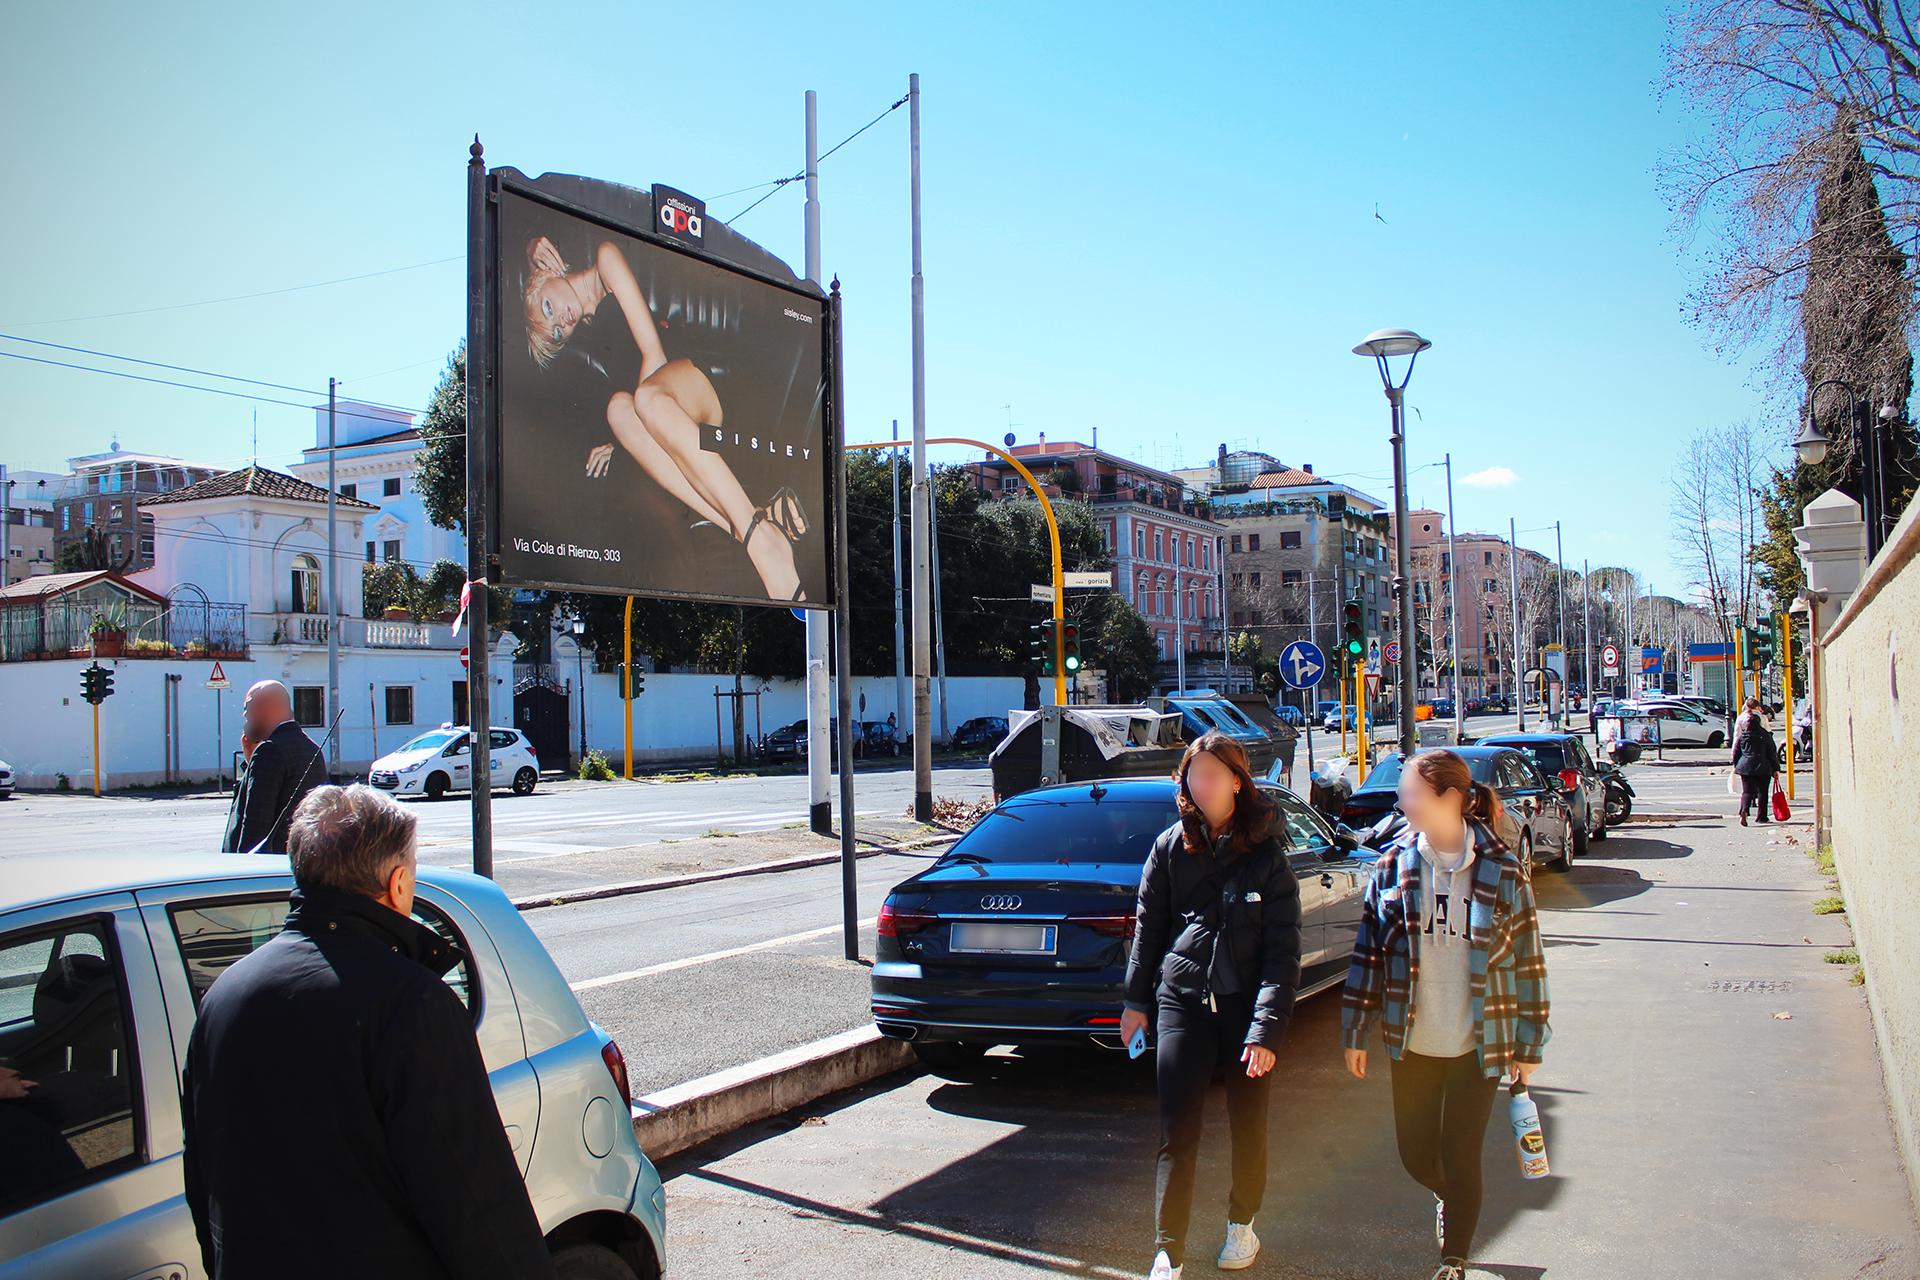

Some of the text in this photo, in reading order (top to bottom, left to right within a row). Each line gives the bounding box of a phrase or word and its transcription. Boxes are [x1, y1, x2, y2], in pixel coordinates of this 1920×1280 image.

[661, 205, 702, 238] apa
[784, 307, 813, 324] sisley.com
[715, 429, 810, 460] SISLEY
[513, 538, 621, 562] Via Cola di Rienzo, 303
[907, 941, 923, 950] A4
